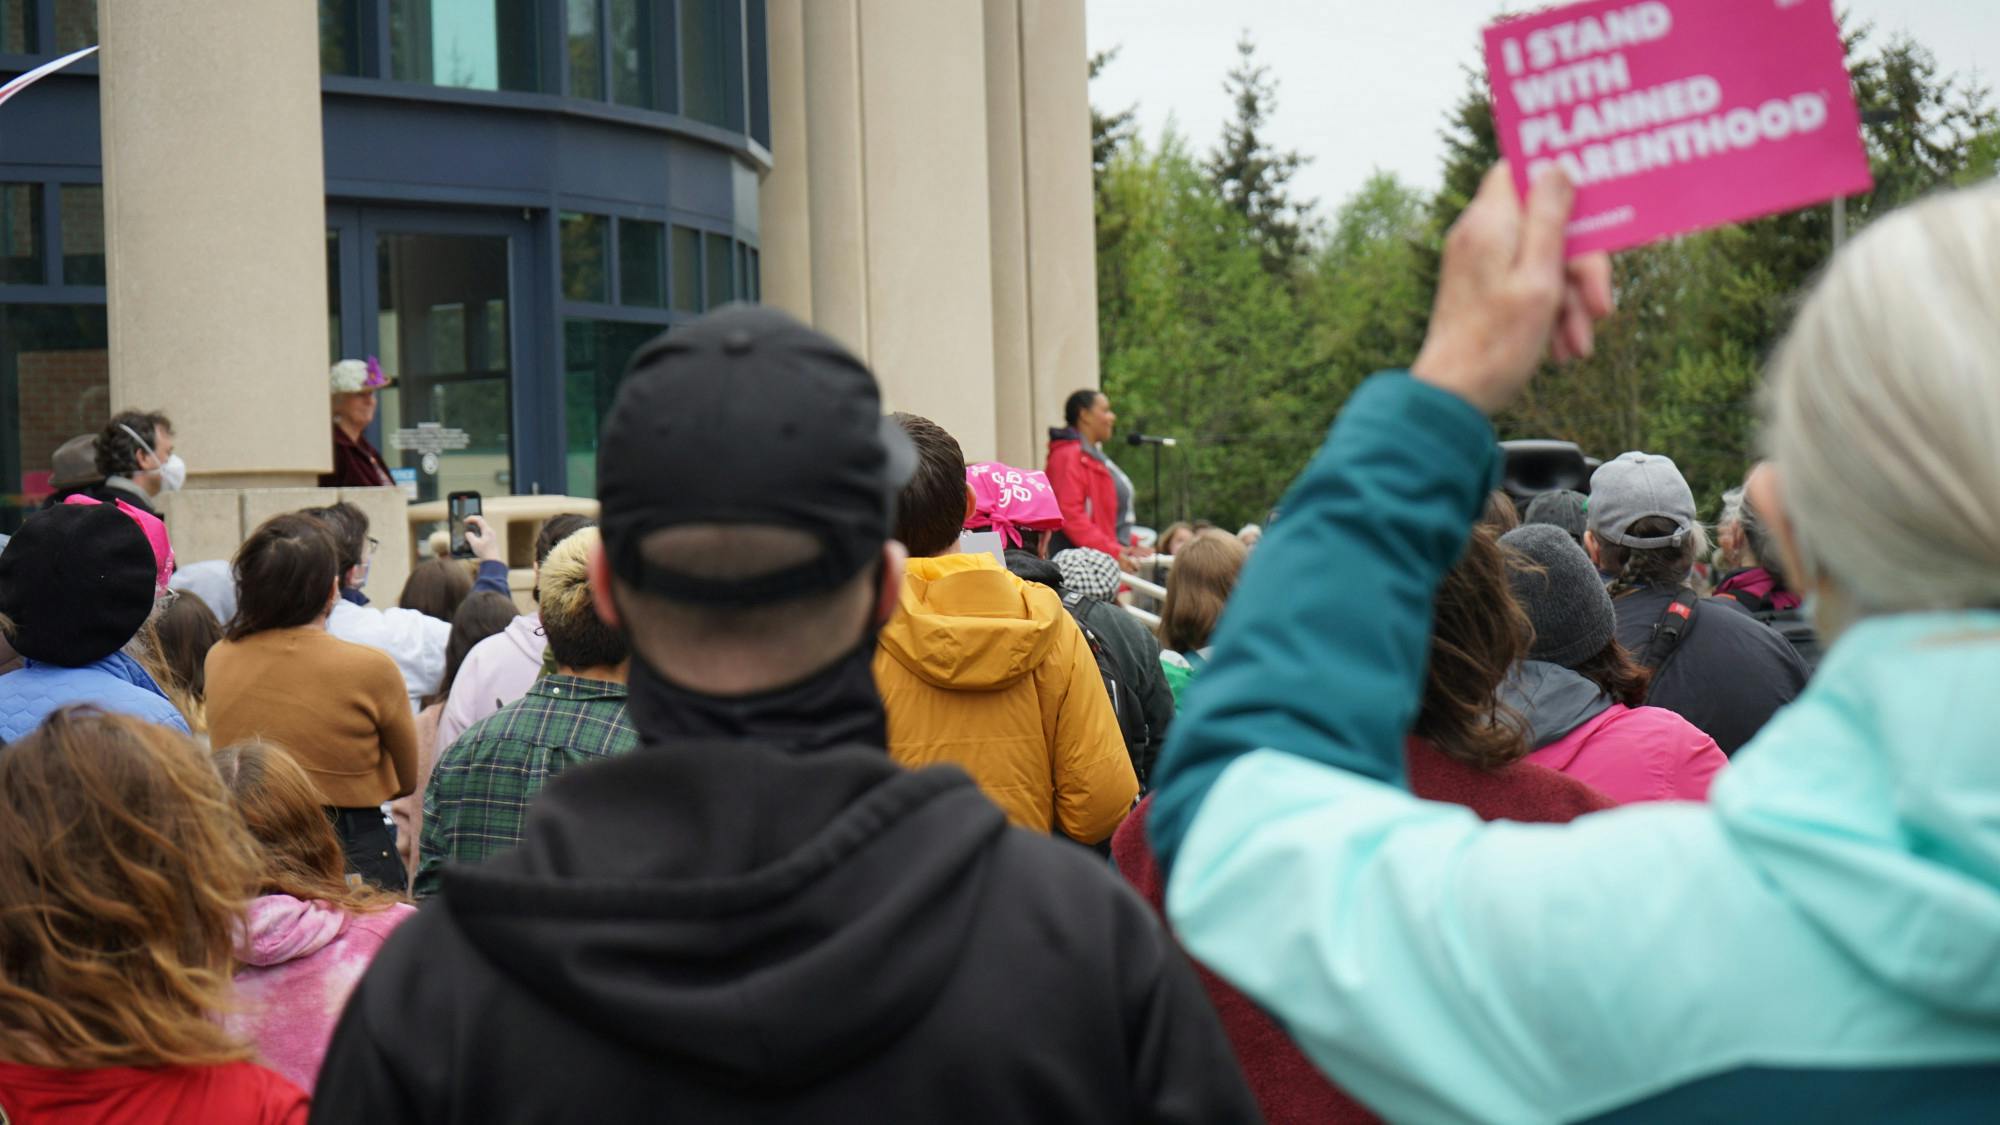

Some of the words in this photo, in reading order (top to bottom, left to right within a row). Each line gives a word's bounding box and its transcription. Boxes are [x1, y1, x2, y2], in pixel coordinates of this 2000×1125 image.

[1502, 37, 1524, 76] I
[1526, 1, 1673, 69] STAND
[1511, 52, 1631, 114] WITH
[1519, 74, 1721, 156] PLANNED
